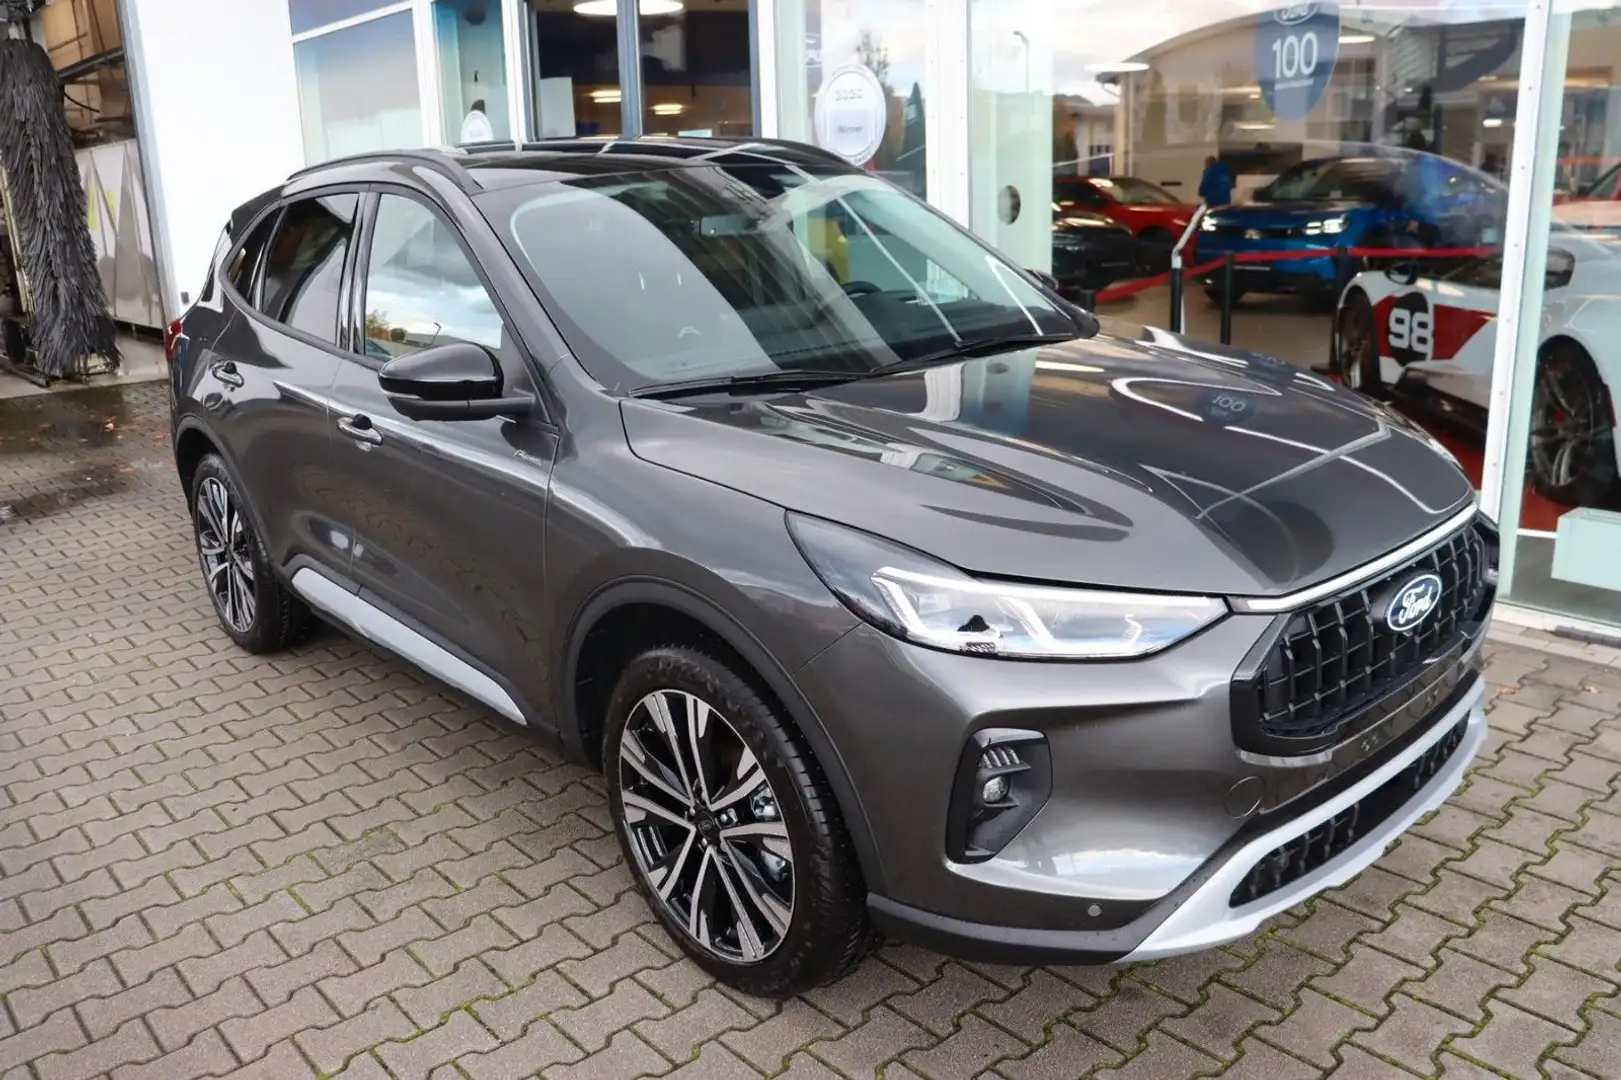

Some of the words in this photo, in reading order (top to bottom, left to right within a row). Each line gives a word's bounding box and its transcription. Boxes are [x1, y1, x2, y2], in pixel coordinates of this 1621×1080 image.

[1272, 32, 1318, 79] 100
[1388, 307, 1433, 354] 98
[1398, 583, 1432, 625] Ford
